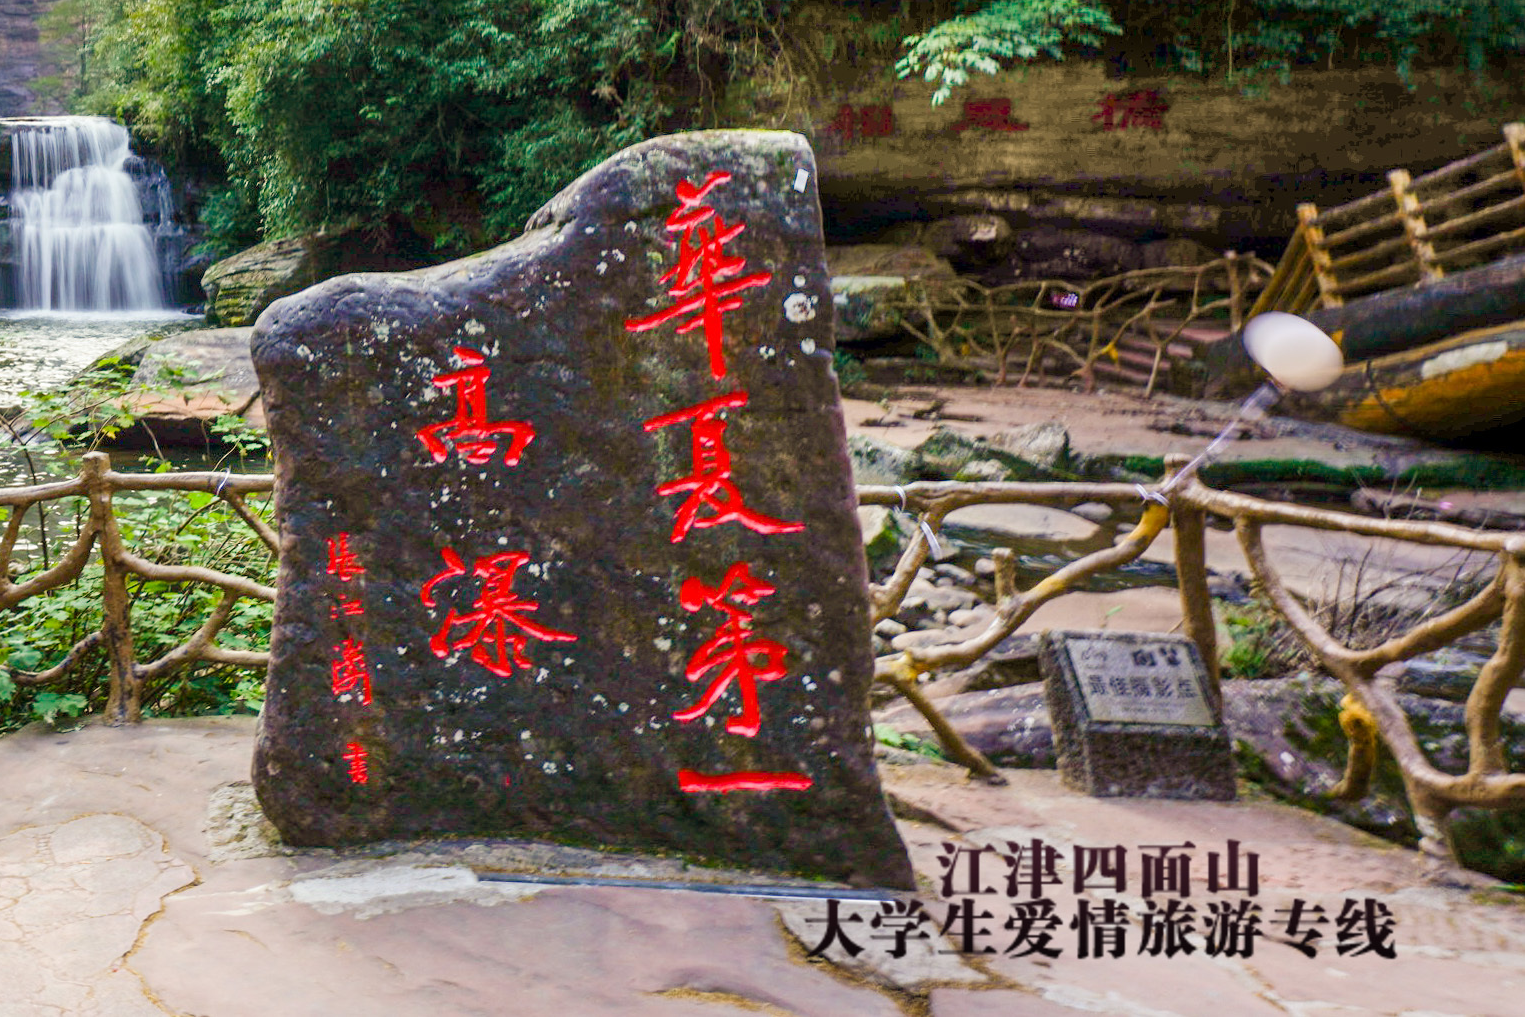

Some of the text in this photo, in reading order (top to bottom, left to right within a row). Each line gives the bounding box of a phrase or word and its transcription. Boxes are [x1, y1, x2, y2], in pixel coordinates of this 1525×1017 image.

[418, 347, 577, 677] 高瀑
[625, 170, 812, 793] 華夏第一
